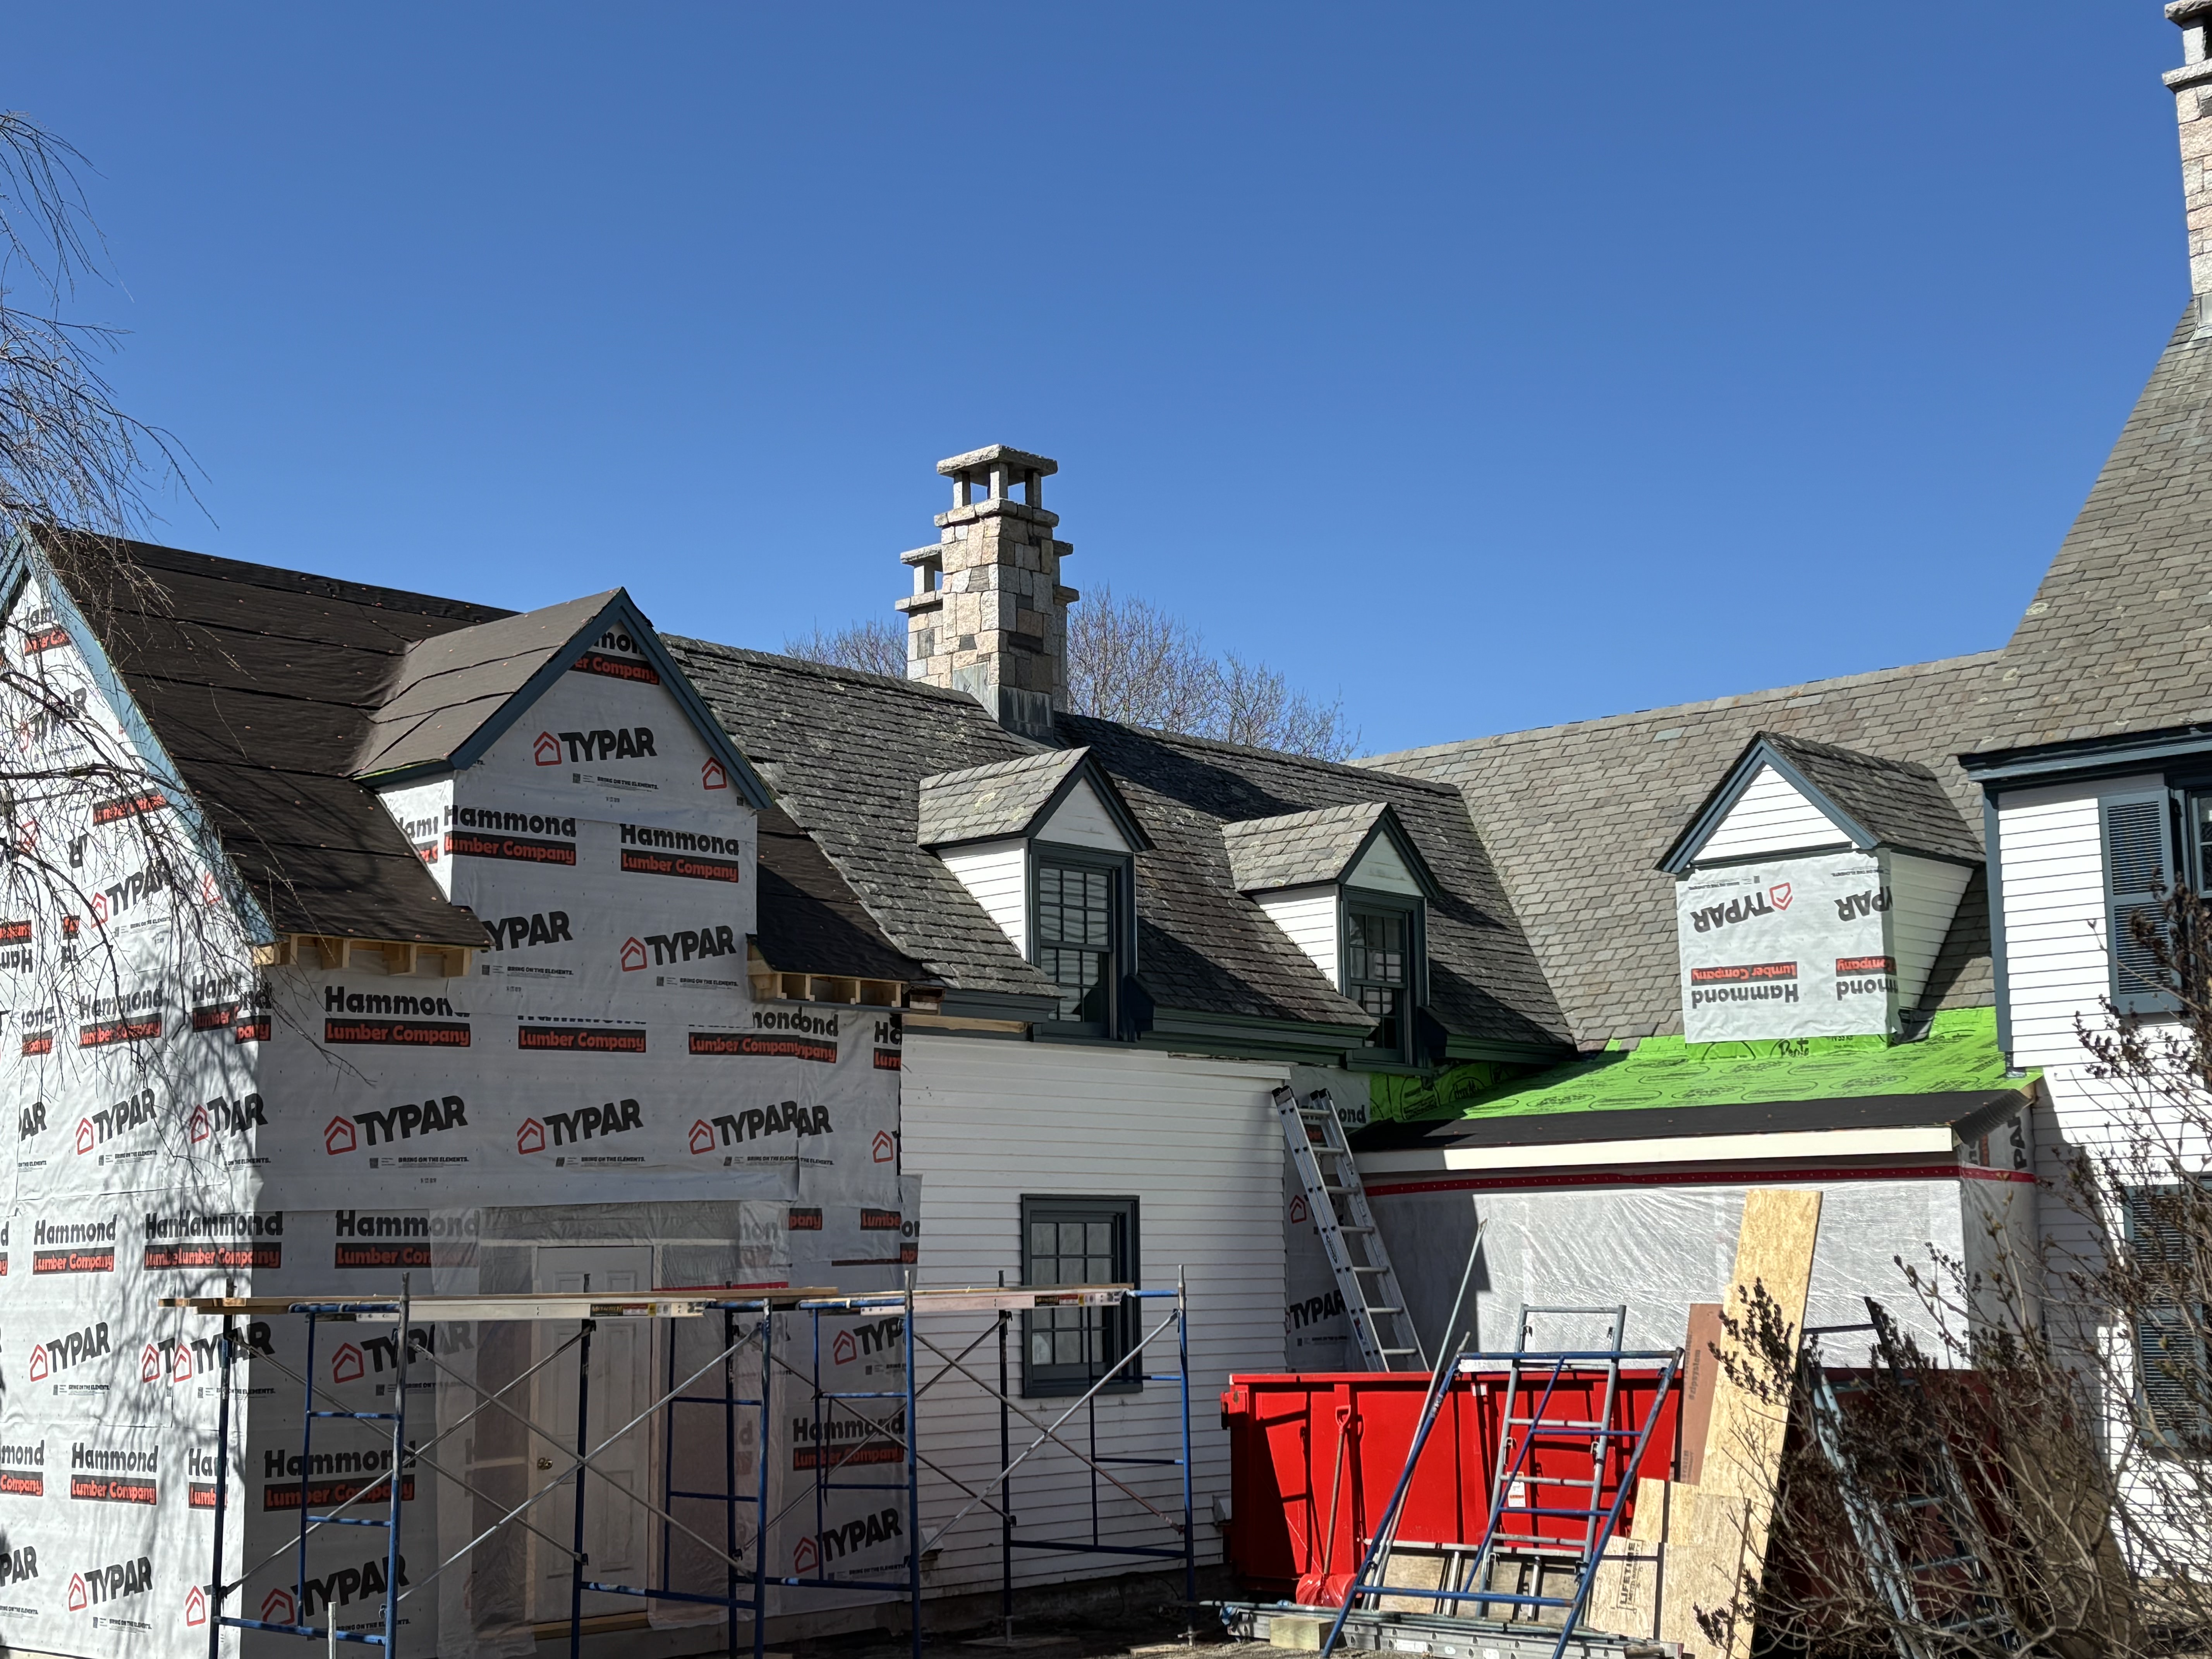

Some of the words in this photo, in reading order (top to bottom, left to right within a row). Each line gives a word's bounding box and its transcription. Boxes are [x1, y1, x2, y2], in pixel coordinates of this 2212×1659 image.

[592, 657, 657, 683] Company
[558, 727, 657, 762] TYPAR
[444, 805, 577, 838] Hammond
[445, 836, 500, 855] Lumber
[504, 841, 575, 865] Company
[623, 853, 672, 872] Lumber
[676, 860, 738, 881] Company
[1690, 891, 1775, 933] TYPAR
[480, 911, 573, 953] YPAR
[644, 925, 737, 966] TYPAR
[80, 980, 163, 1020] Hammond
[1691, 983, 1800, 1009] Hammond
[328, 1022, 388, 1041] Lumber
[392, 1025, 470, 1046] Company
[520, 1029, 575, 1047] Lumber
[577, 1032, 645, 1052] Company
[690, 1036, 738, 1053] Lumber
[742, 1037, 800, 1056] Company
[92, 1088, 156, 1144] TYPAR
[353, 1095, 468, 1146] TYPAR
[543, 1099, 644, 1146] TYPAR
[34, 1214, 117, 1245] Hammond
[34, 1254, 67, 1271] Lumber
[69, 1253, 114, 1272] Company
[337, 1246, 398, 1265] Lumber
[46, 1322, 111, 1373] TYPAR
[72, 1442, 158, 1473] Hammond
[0, 1474, 42, 1496] Company
[72, 1479, 108, 1498] Lumber
[109, 1481, 155, 1503] Company
[0, 1546, 38, 1587] PAR
[84, 1556, 153, 1604] TYPAR
